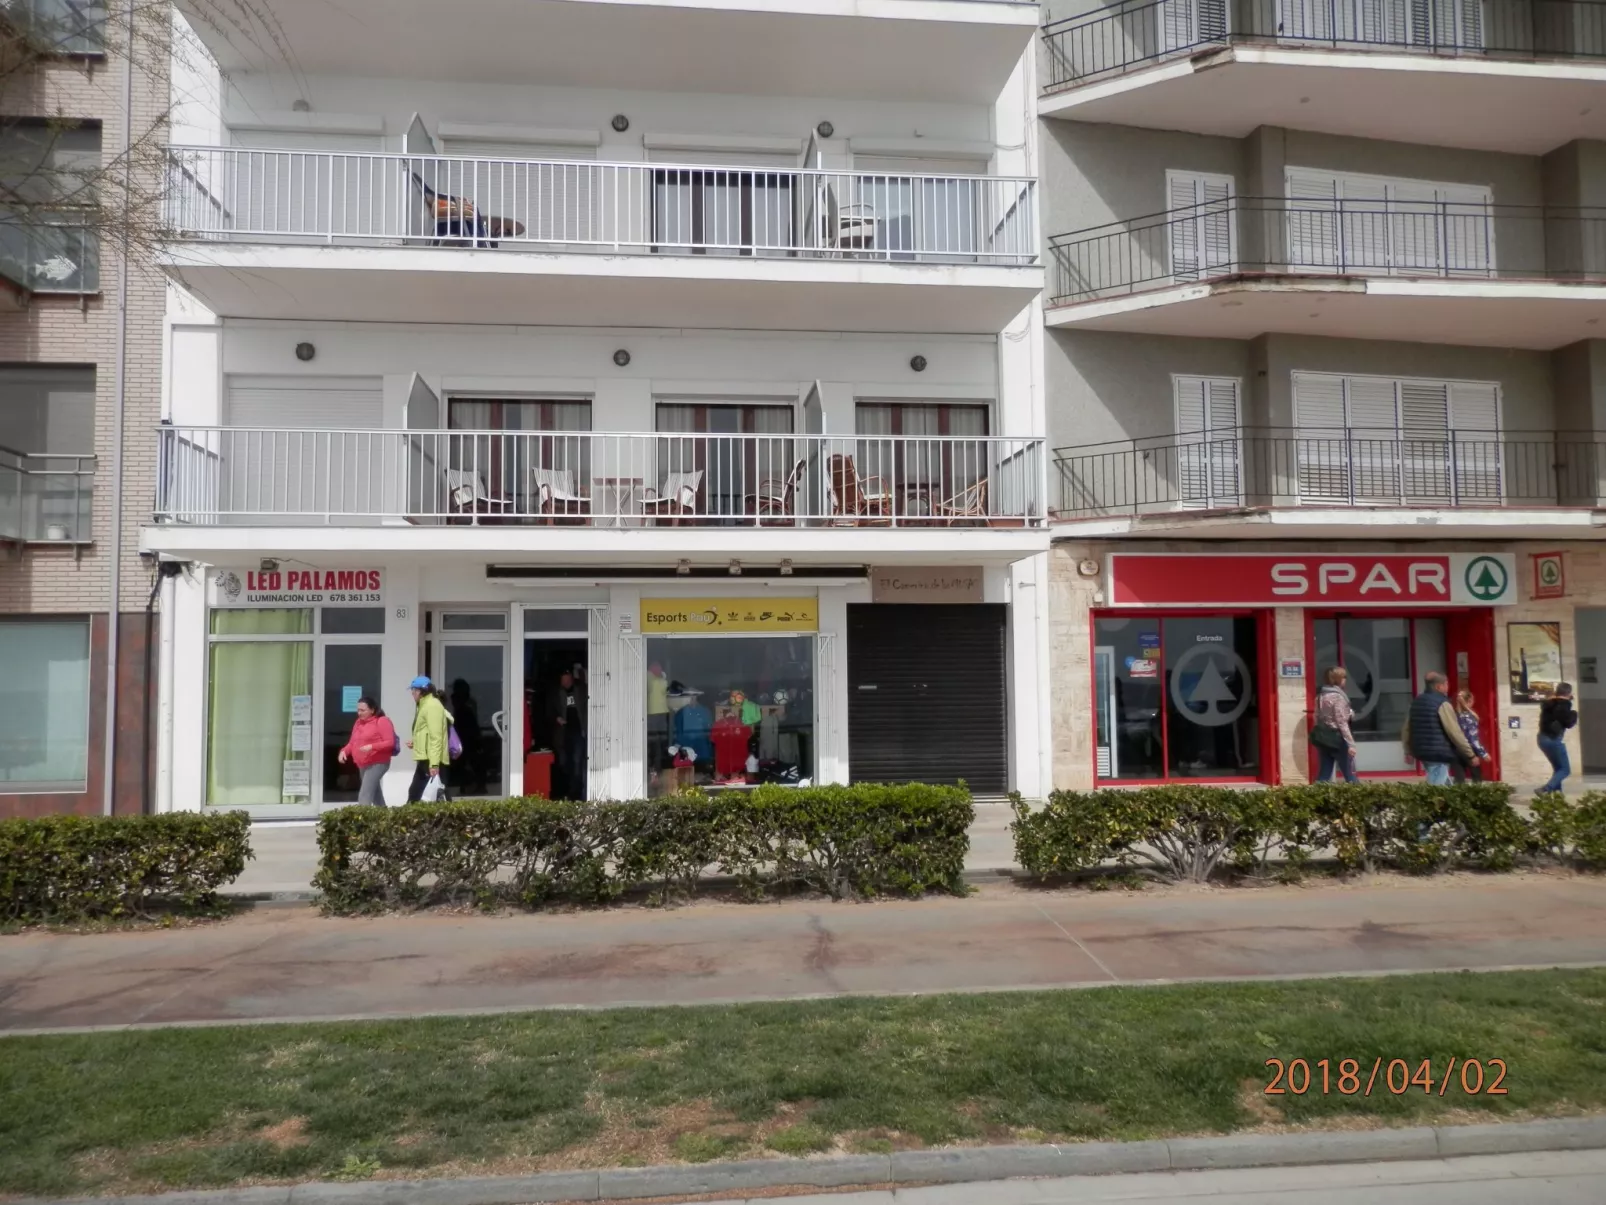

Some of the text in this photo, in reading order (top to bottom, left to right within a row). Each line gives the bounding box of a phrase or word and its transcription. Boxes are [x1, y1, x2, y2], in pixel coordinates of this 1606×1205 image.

[247, 570, 381, 590] LED PALAMOS
[1271, 562, 1446, 595] SPAR
[247, 593, 381, 602] ILUMINACION LED 678 361 153
[396, 608, 406, 618] 83
[646, 612, 687, 625] Esports
[1196, 634, 1223, 642] Entrada
